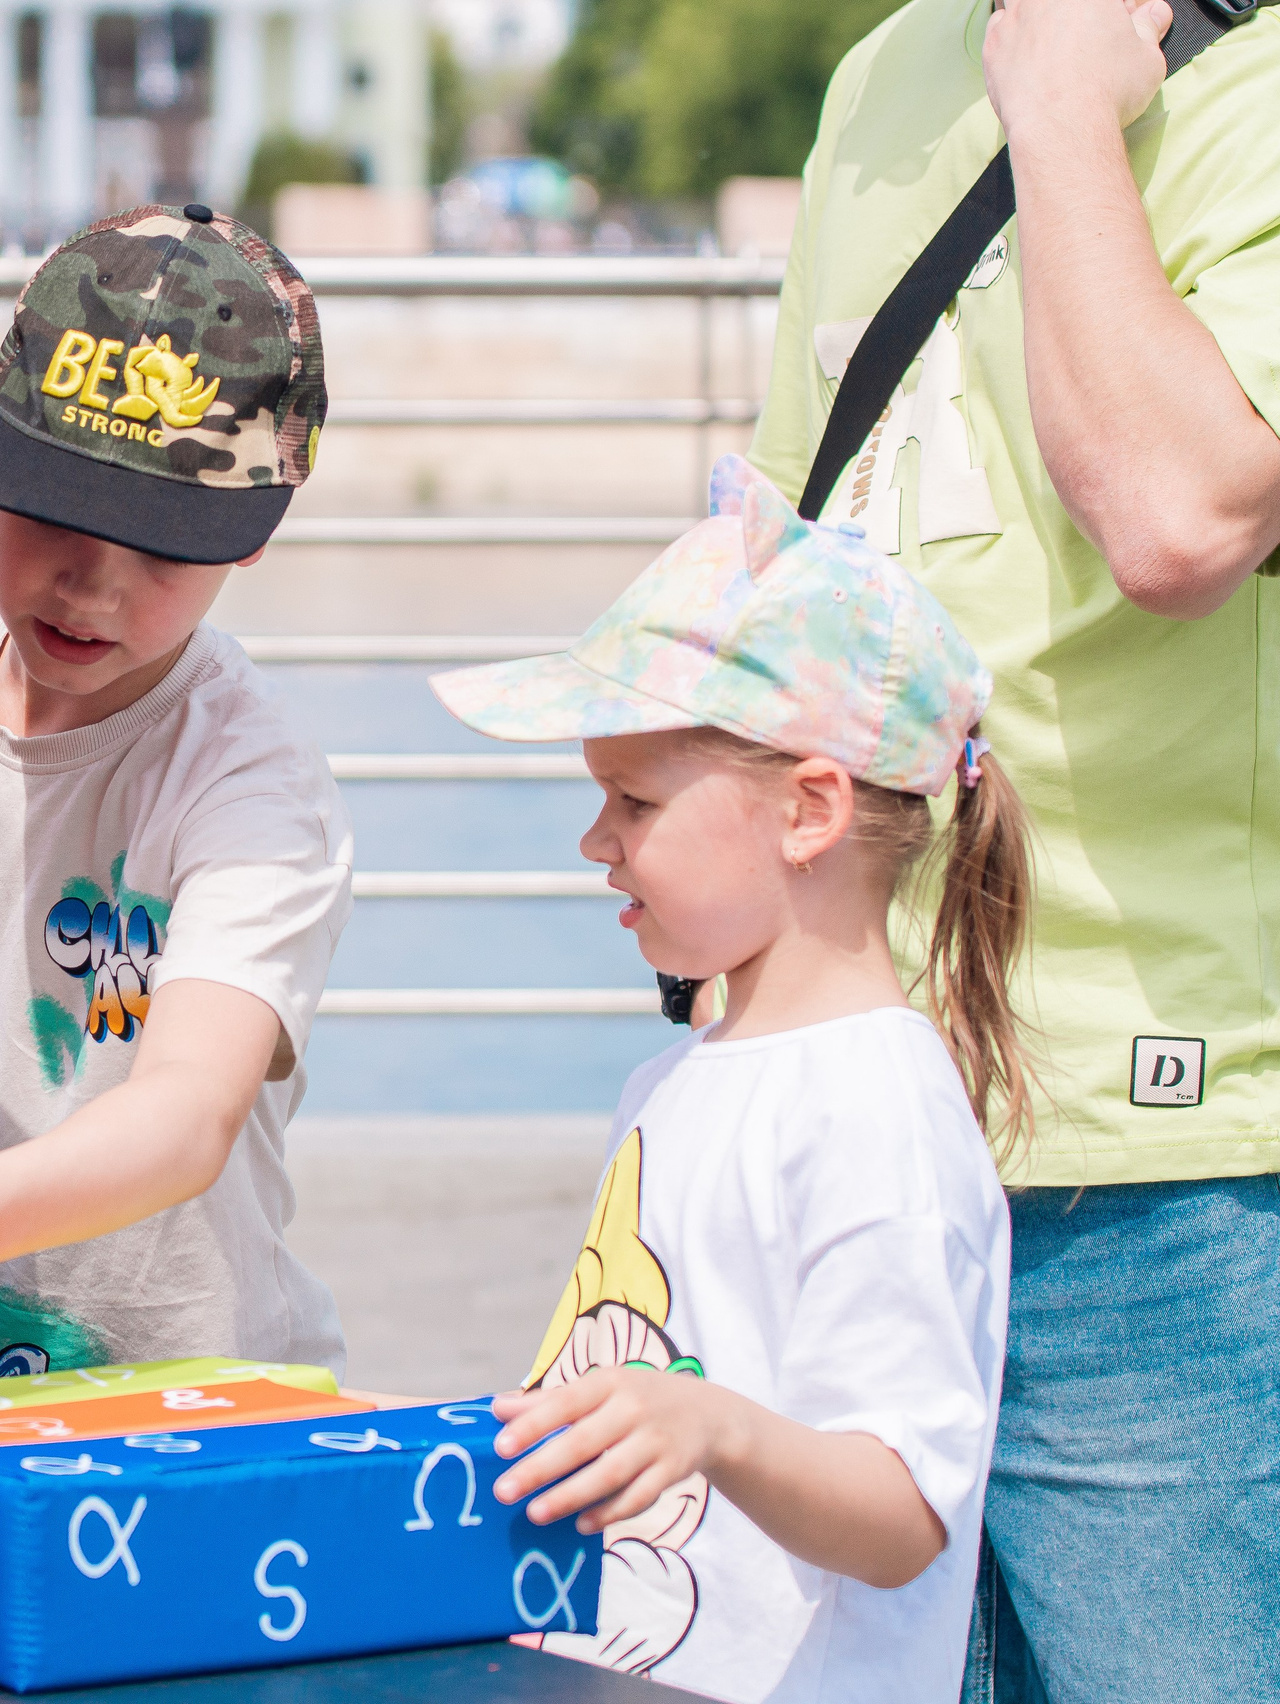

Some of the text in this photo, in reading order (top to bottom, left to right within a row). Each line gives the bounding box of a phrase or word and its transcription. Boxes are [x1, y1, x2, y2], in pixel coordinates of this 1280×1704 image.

[40, 328, 125, 411] BE
[61, 405, 166, 448] STRONG
[1149, 1054, 1186, 1088] D
